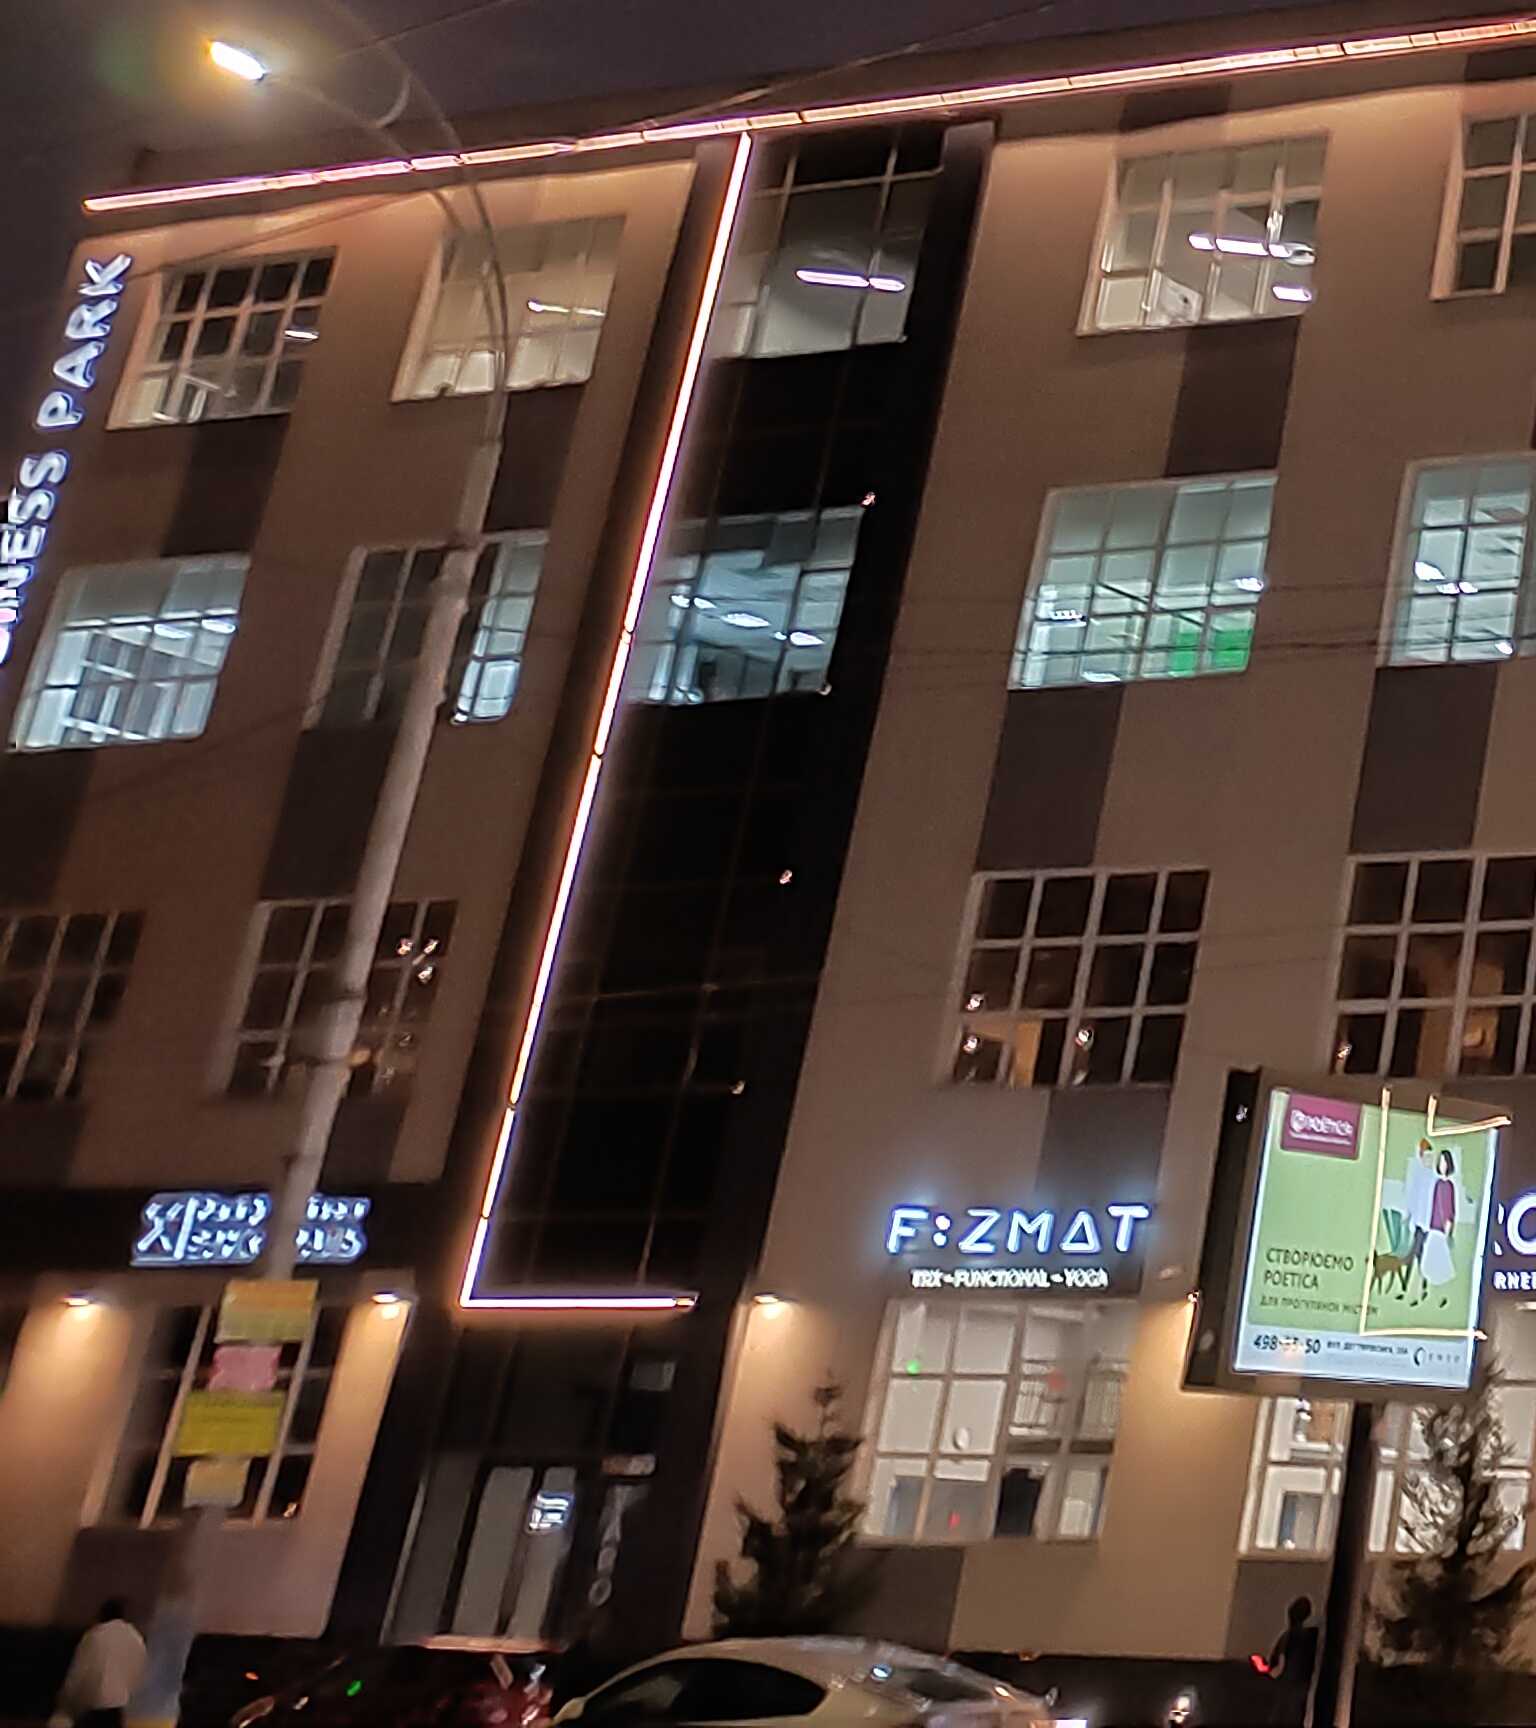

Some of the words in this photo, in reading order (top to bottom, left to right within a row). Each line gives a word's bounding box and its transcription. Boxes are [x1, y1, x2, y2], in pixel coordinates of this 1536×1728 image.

[37, 254, 132, 428] PARK
[1266, 1248, 1354, 1271] СТВОРЮЄМО
[1264, 1270, 1319, 1288] POETICA
